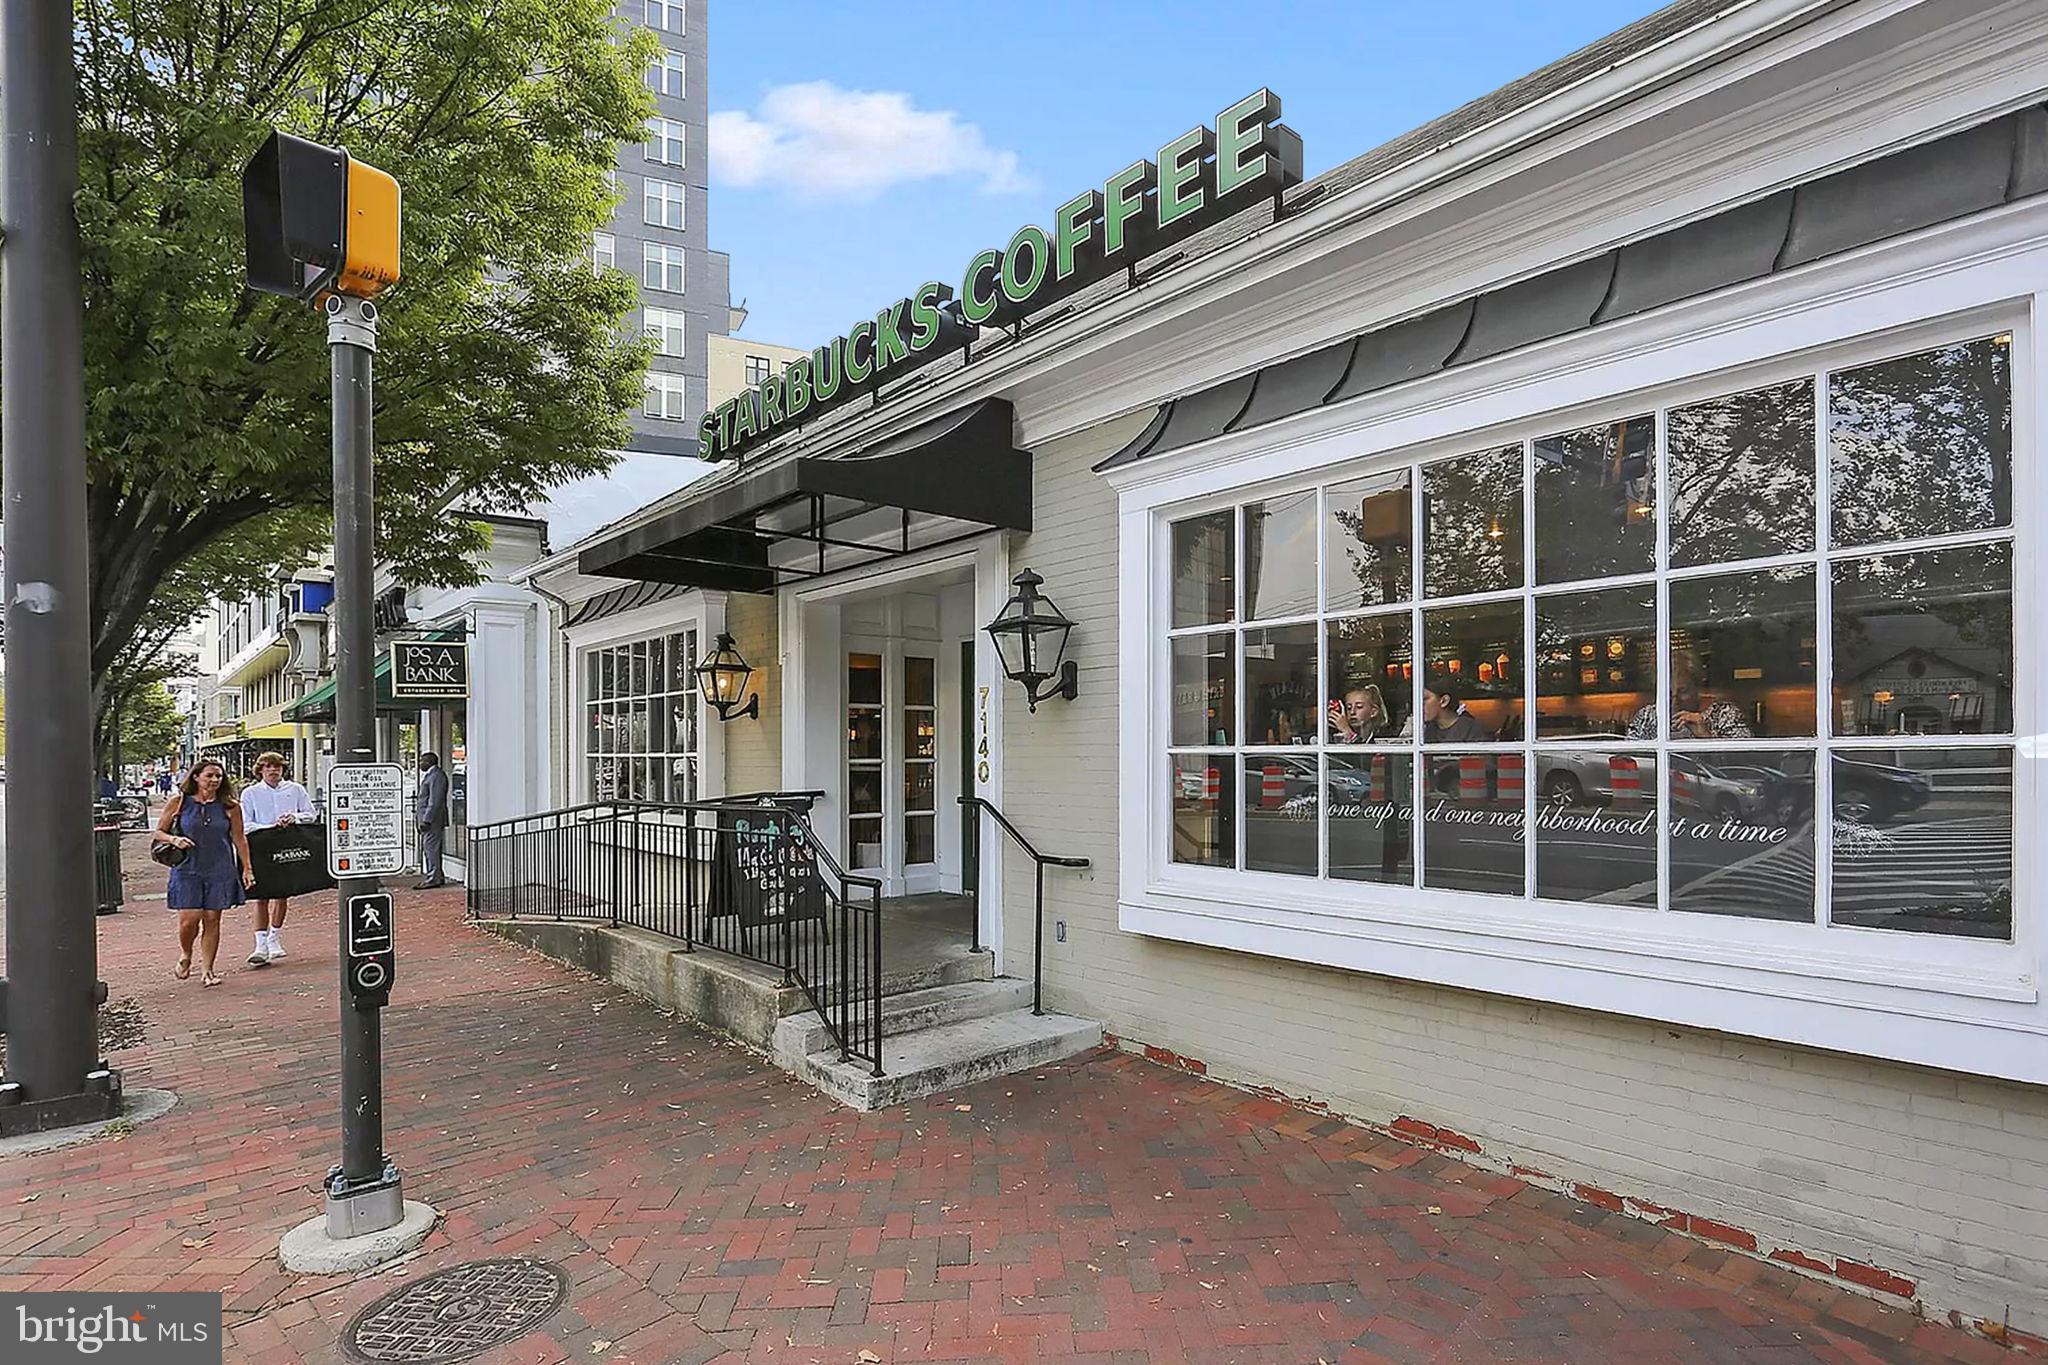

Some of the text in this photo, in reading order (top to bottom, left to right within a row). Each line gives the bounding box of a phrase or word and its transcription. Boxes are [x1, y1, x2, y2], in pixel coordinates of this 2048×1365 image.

[697, 87, 1270, 462] STARBUCKS COFFEE
[405, 667, 457, 682] BANK
[978, 687, 990, 783] 7140
[1327, 804, 1361, 818] one
[1364, 801, 1394, 829] cup
[1398, 800, 1445, 822] ad
[1445, 808, 1484, 825] one
[1488, 804, 1656, 842] neighborhood
[1691, 822, 1713, 839] a
[1719, 816, 1787, 843] time
